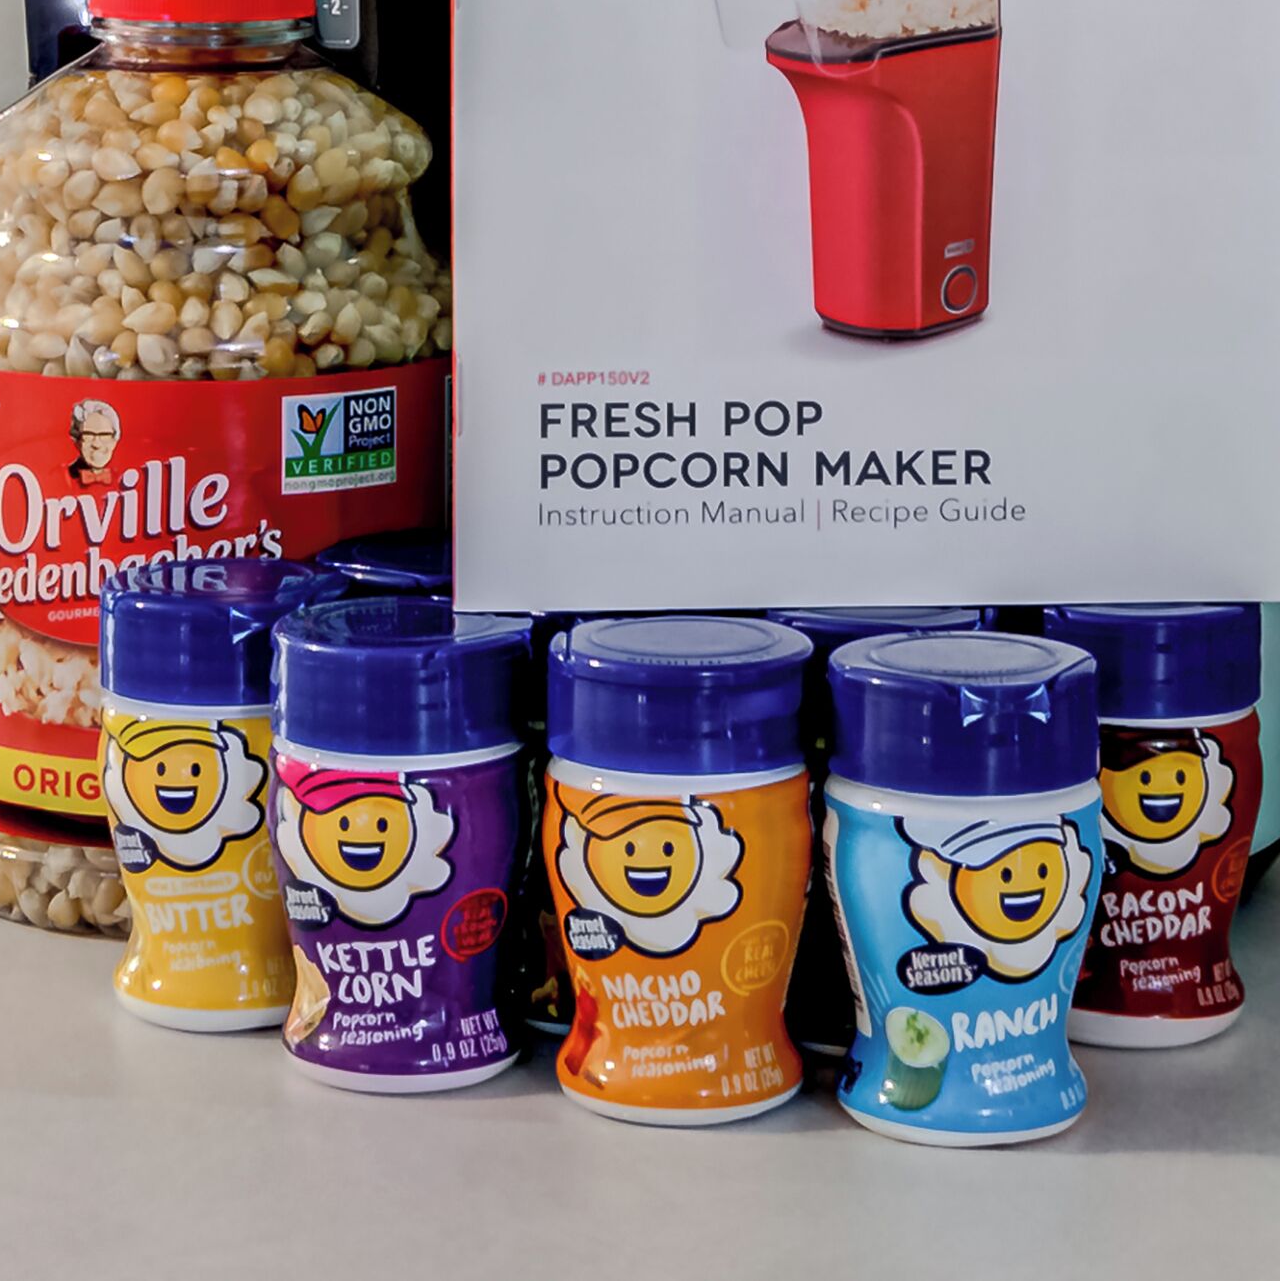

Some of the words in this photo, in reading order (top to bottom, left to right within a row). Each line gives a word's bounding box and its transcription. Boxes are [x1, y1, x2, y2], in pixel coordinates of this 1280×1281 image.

[551, 371, 650, 386] DAPP150V2
[350, 395, 391, 416] NON
[540, 401, 696, 438] FRESH
[724, 400, 823, 437] POP
[349, 414, 391, 434] GMO
[349, 433, 390, 449] Project
[292, 451, 391, 475] VERIFIED
[540, 451, 788, 489] POPCORN
[815, 450, 992, 486] MAKER
[539, 502, 689, 526] Instruction
[701, 499, 805, 524] Manual
[832, 499, 928, 528] Recipe
[939, 497, 1026, 522] Guide
[48, 607, 99, 622] GOURME
[13, 764, 101, 800] ORIG
[1102, 882, 1203, 918] BACON
[145, 893, 254, 935] BUTTER
[1100, 906, 1212, 947] CHEDDAR
[316, 934, 436, 973] KETTLE
[912, 947, 967, 968] Kernel
[1120, 957, 1179, 977] Popcorn
[338, 969, 422, 1007] CORN
[601, 970, 701, 1002] NACHO
[333, 1011, 396, 1031] Popcorn
[612, 991, 726, 1028] CHEDDAR
[952, 993, 1058, 1053] RANCH
[340, 1022, 428, 1046] seasoning
[459, 1038, 479, 1059] OZ
[623, 1045, 689, 1064] Popcorn
